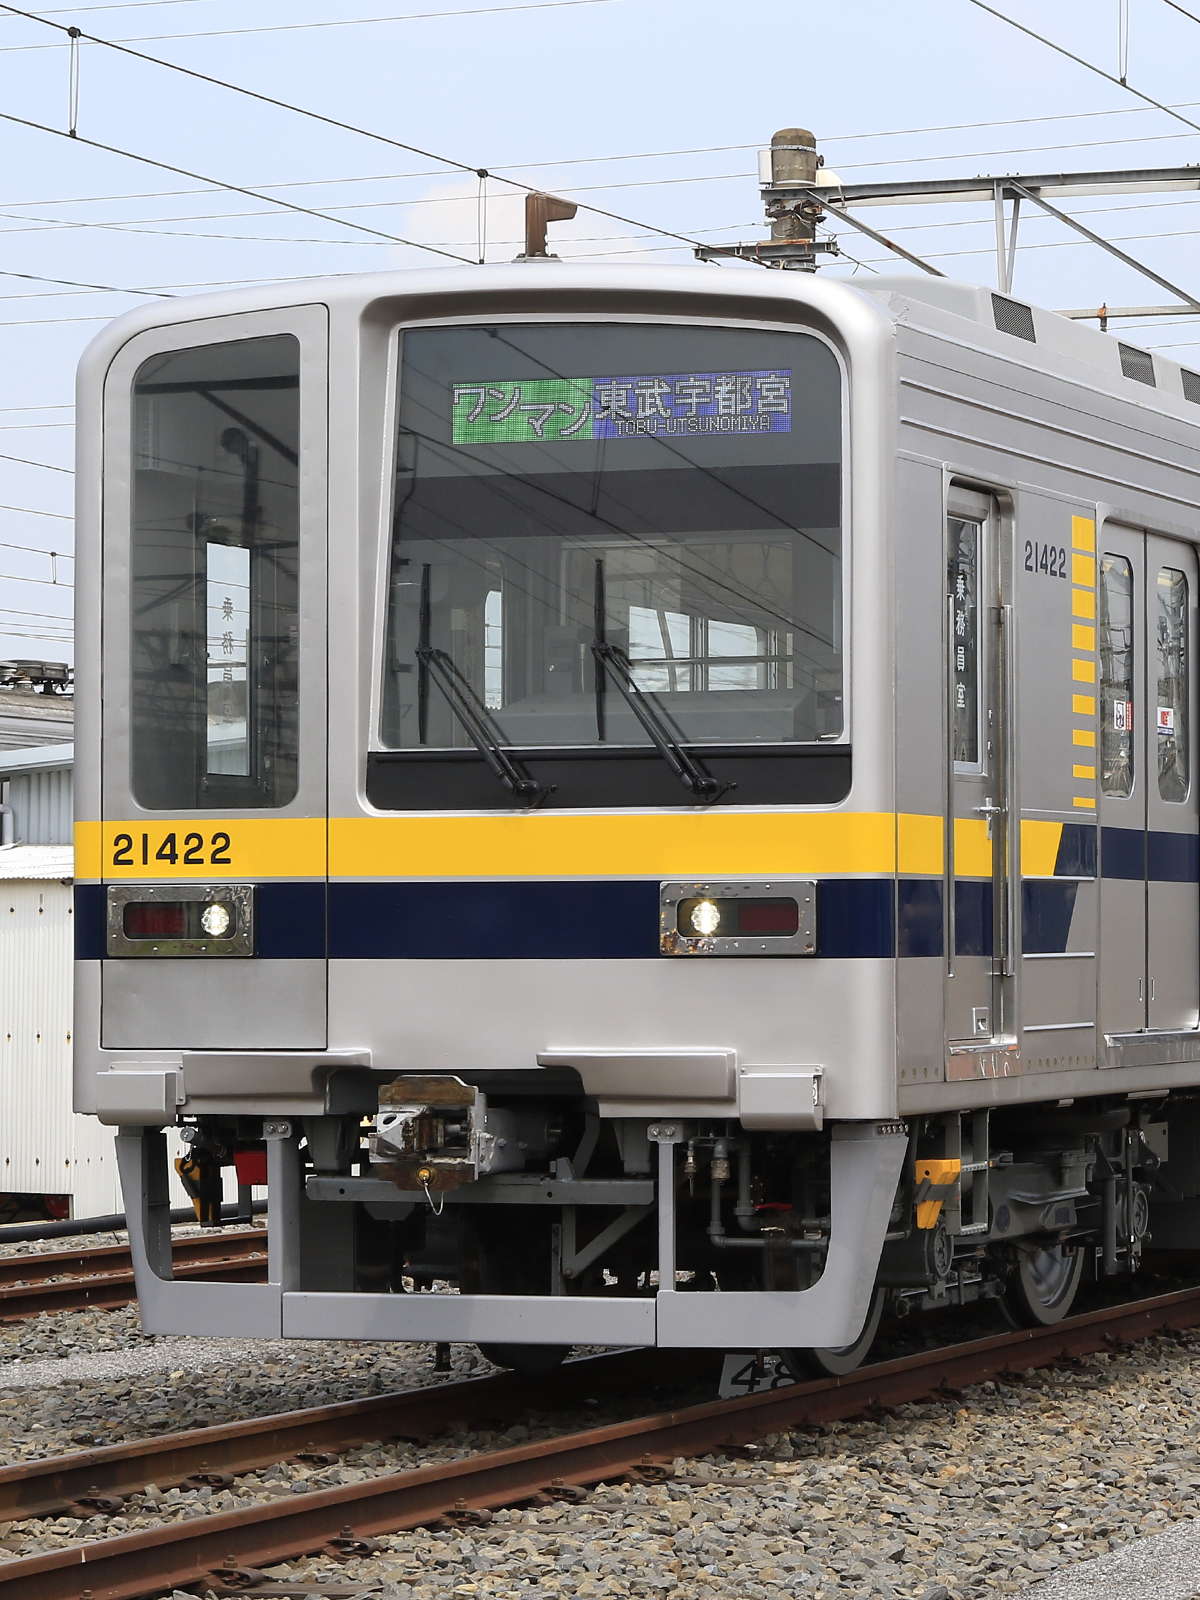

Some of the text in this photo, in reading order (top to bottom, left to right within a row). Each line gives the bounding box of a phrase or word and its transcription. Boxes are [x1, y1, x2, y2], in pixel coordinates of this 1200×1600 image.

[453, 387, 591, 436] ワンマン
[595, 374, 791, 419] 東武宇都宮
[615, 414, 770, 435] TOBU-UTSUNOMIYA
[1024, 540, 1067, 579] 21422
[955, 573, 967, 709] 乗務員室
[112, 832, 232, 866] 21422
